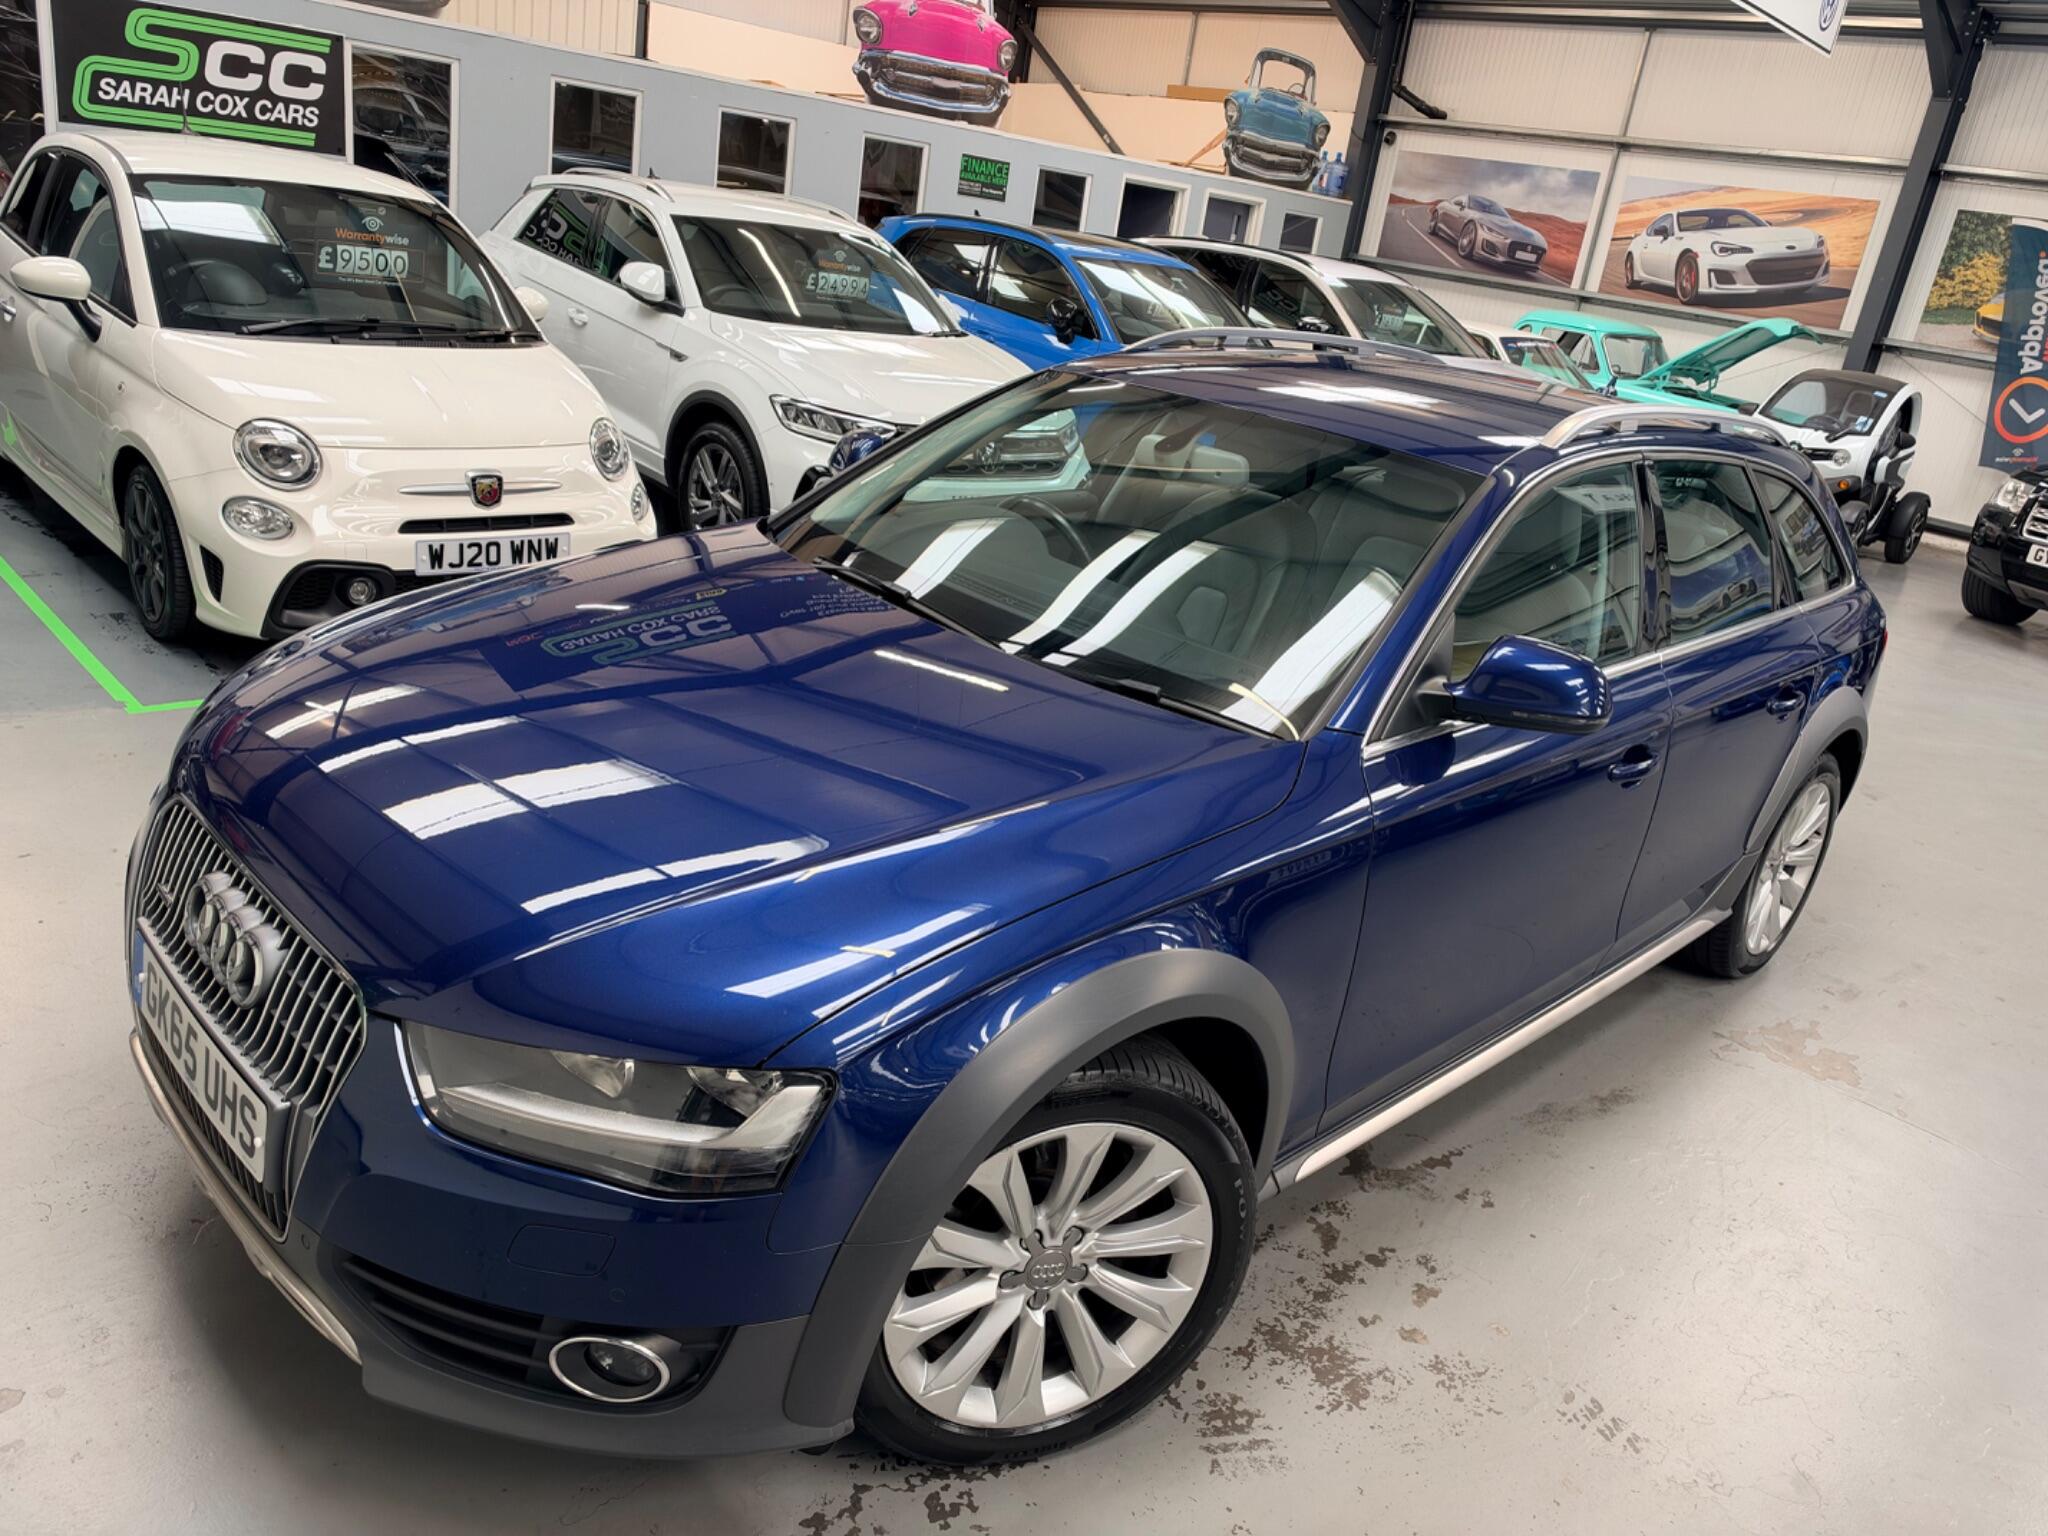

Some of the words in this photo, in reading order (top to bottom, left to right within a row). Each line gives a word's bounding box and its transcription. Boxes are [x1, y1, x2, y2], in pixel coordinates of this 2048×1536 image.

[97, 77, 190, 110] SARAH
[195, 91, 250, 119] COX
[253, 99, 320, 127] CARS
[961, 156, 1009, 179] FINANCE
[335, 227, 410, 246] Warrantywise
[318, 245, 407, 275] £9500
[428, 540, 501, 570] WJ20
[510, 537, 559, 565] WNW
[146, 960, 198, 1082] GK65
[203, 1046, 258, 1159] UHS
